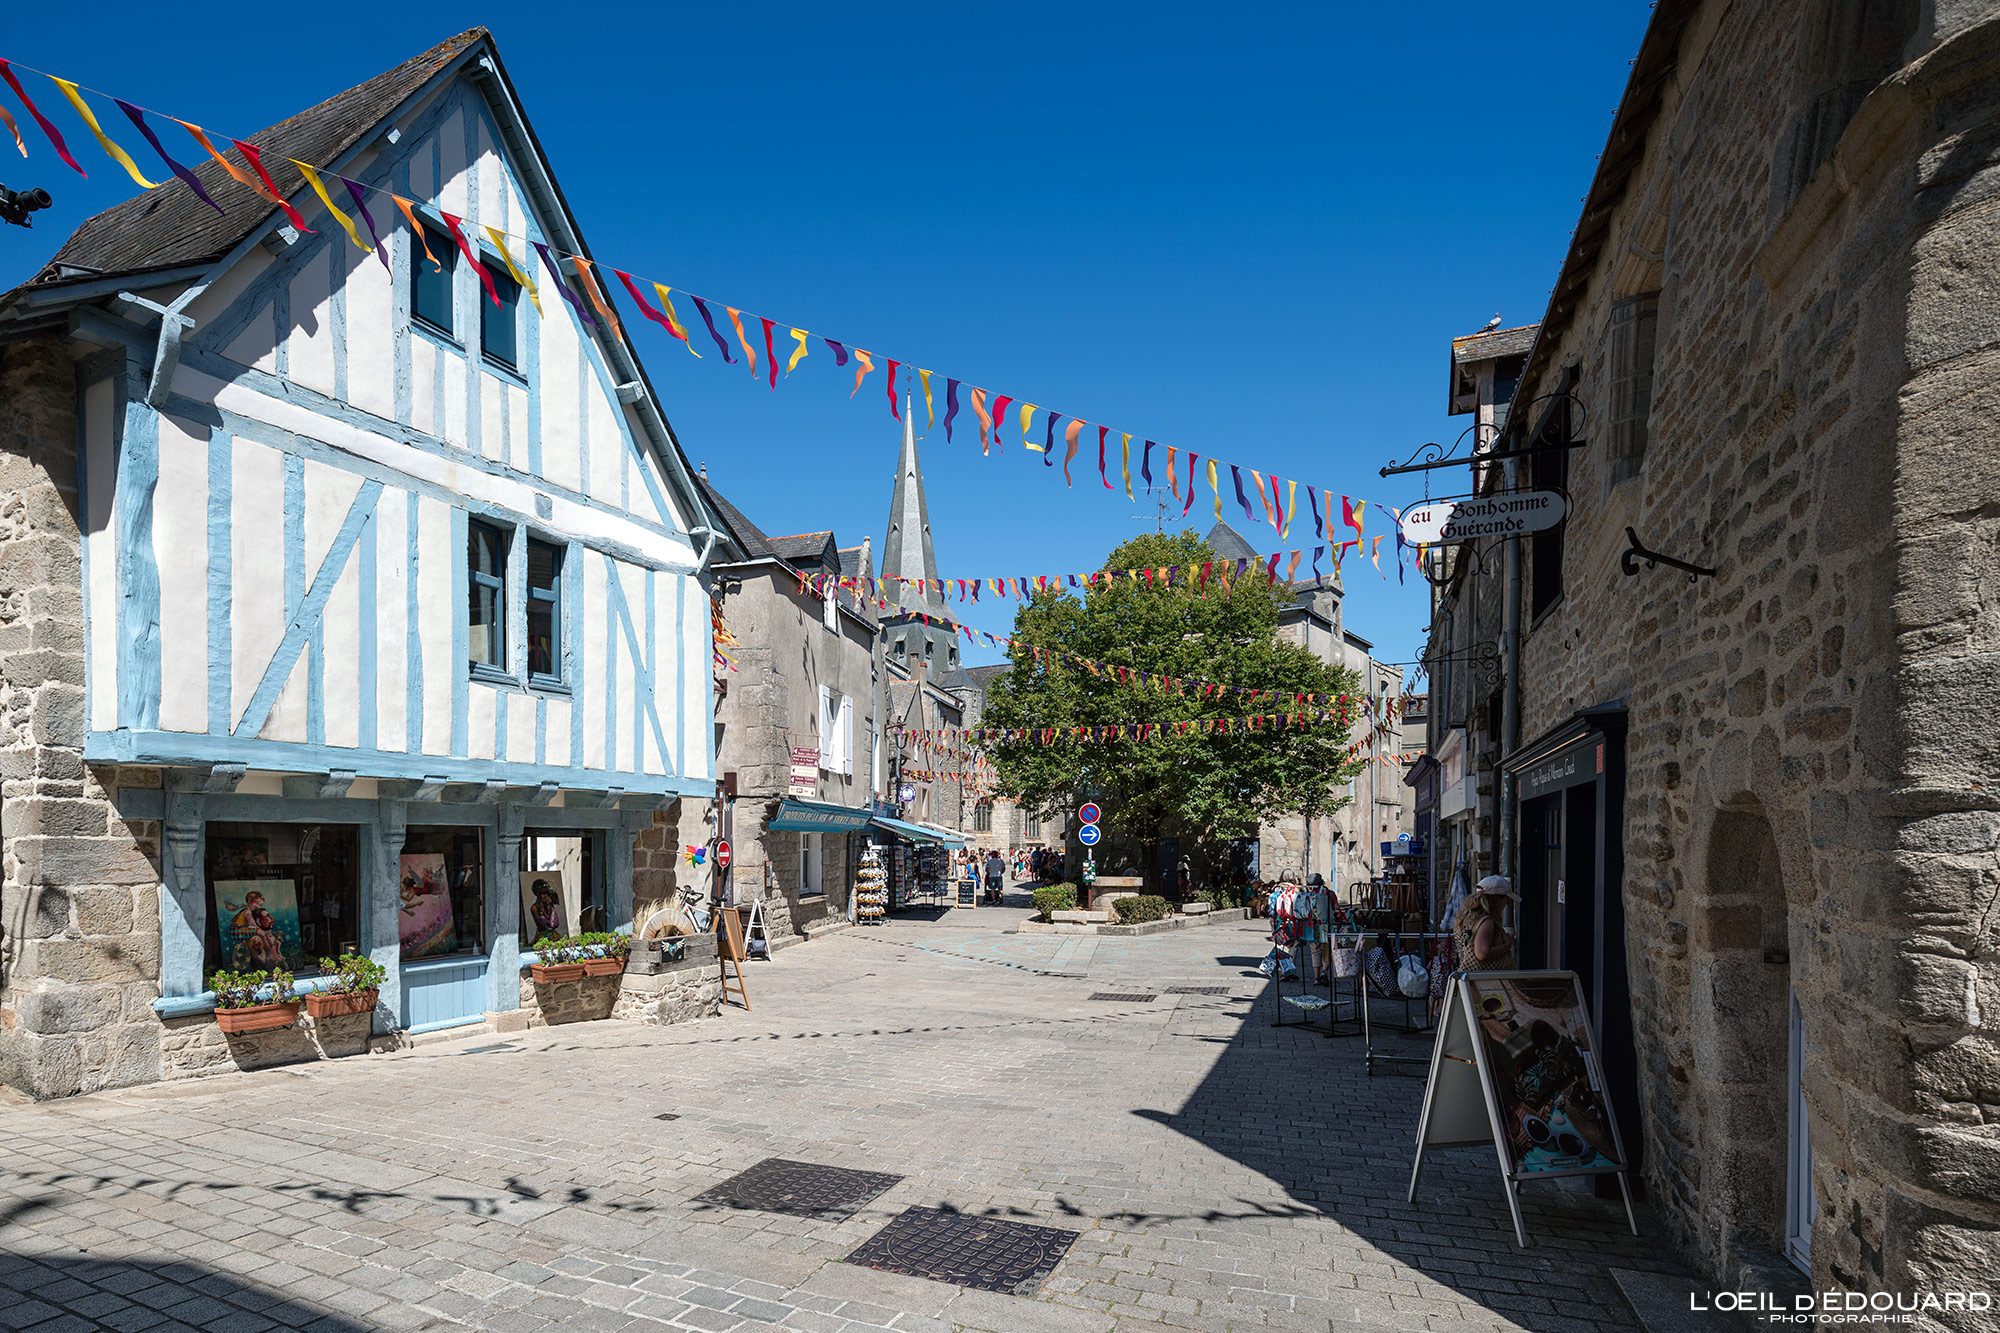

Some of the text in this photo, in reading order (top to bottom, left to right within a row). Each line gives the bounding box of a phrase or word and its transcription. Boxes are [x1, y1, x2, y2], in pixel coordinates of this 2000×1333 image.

[1411, 496, 1549, 524] au Bonhomme
[1440, 516, 1525, 539] Guérande
